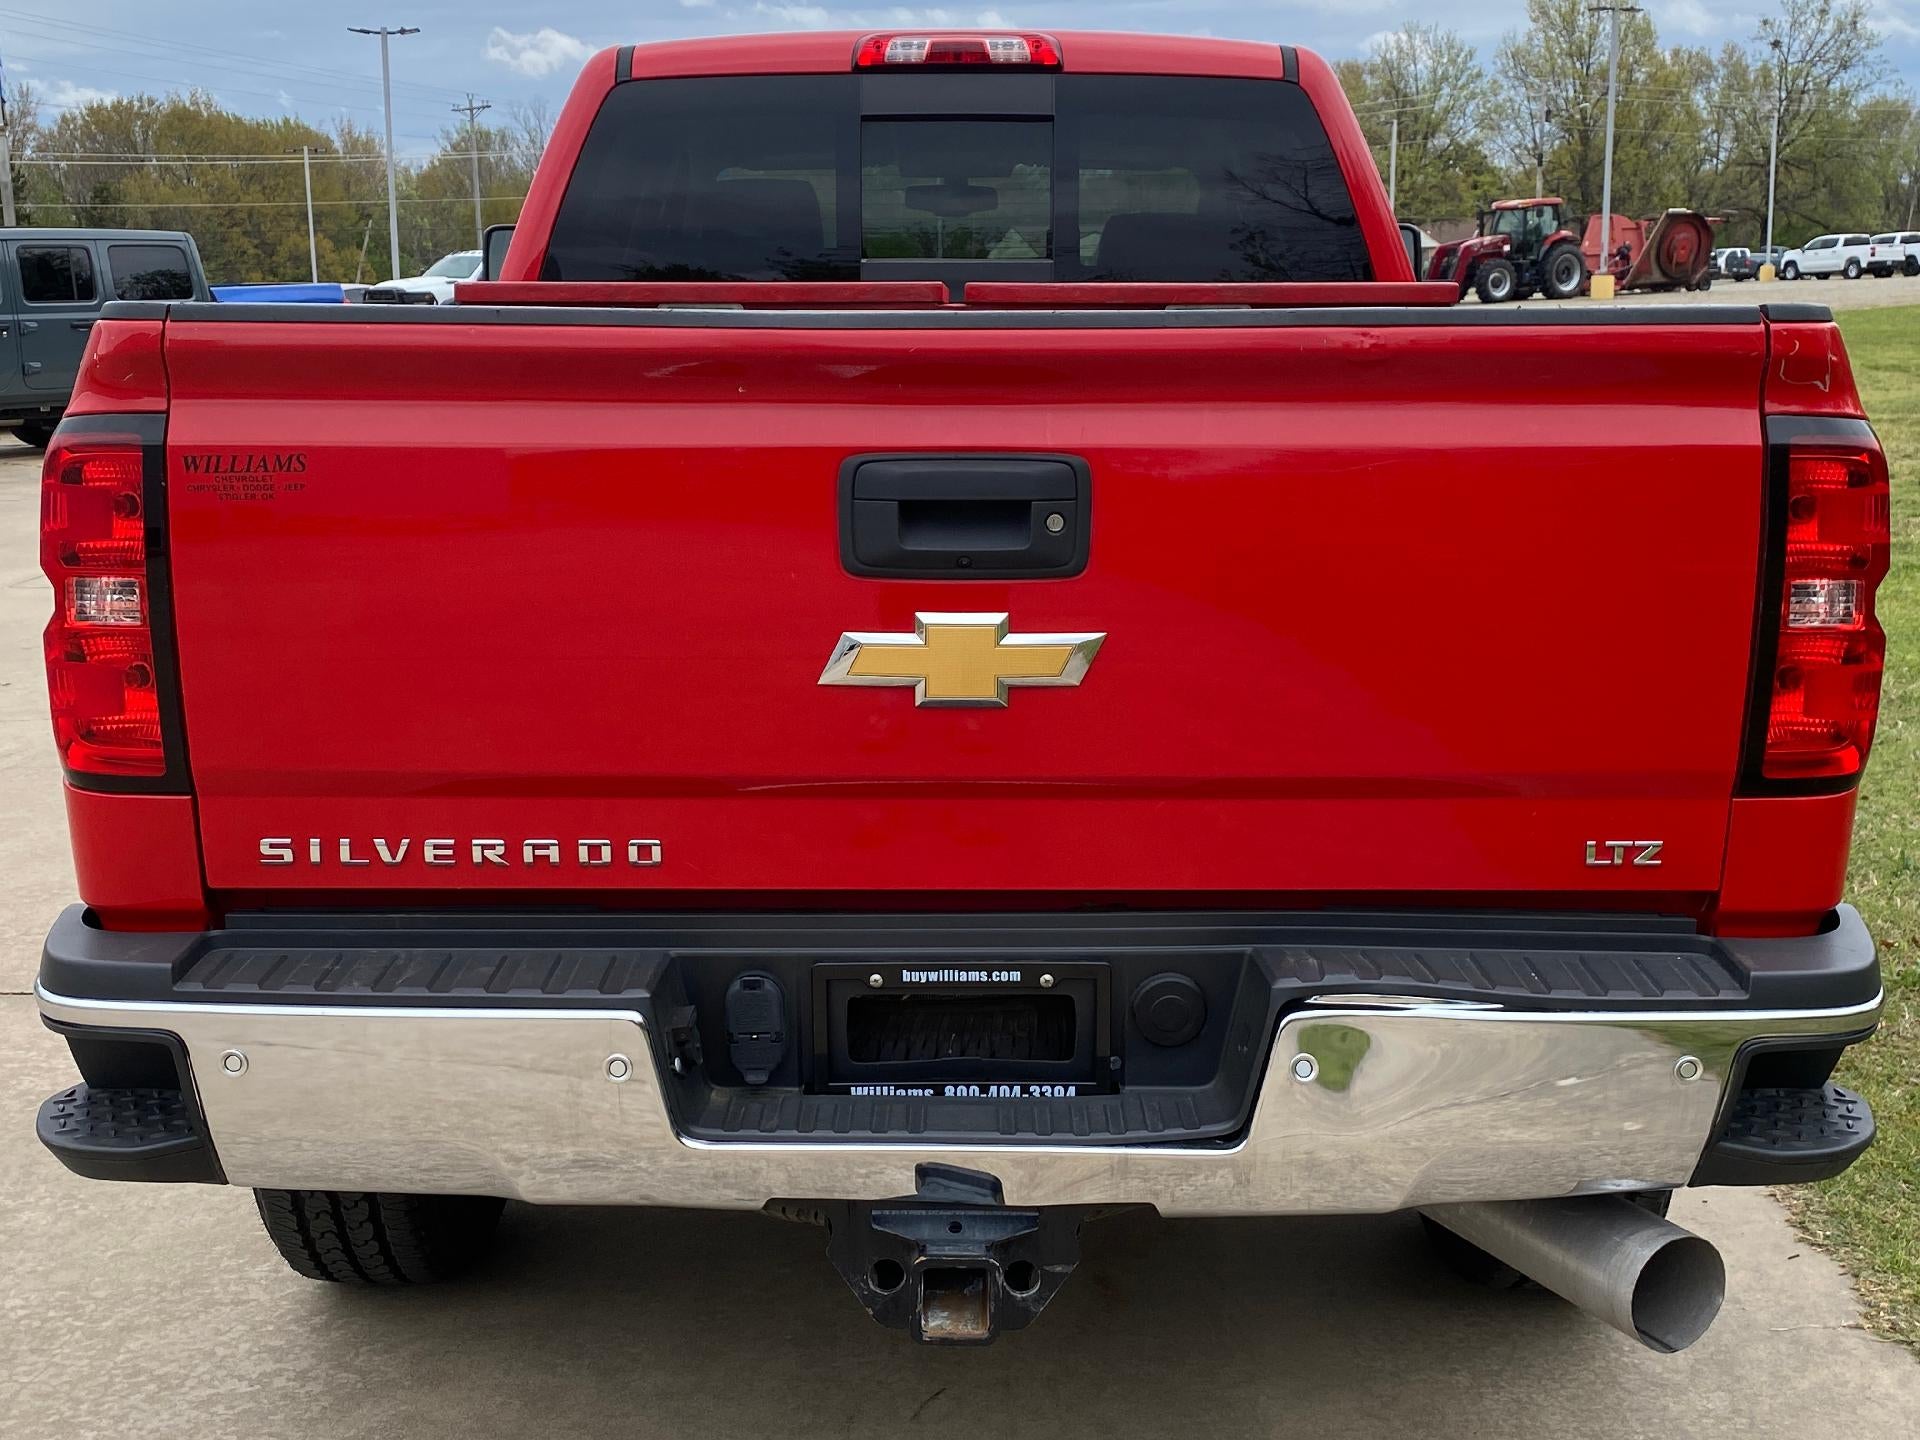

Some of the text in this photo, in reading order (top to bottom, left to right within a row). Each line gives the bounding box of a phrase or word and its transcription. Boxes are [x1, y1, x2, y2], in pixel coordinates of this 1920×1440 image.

[182, 453, 307, 474] WILLIAMS
[186, 482, 306, 492] CHRYSLER DODGE JEEP
[214, 475, 274, 483] CHEVROLET
[259, 838, 662, 867] SILVERADO
[1586, 840, 1664, 865] LTZ
[902, 969, 1022, 983] buywilliams.com
